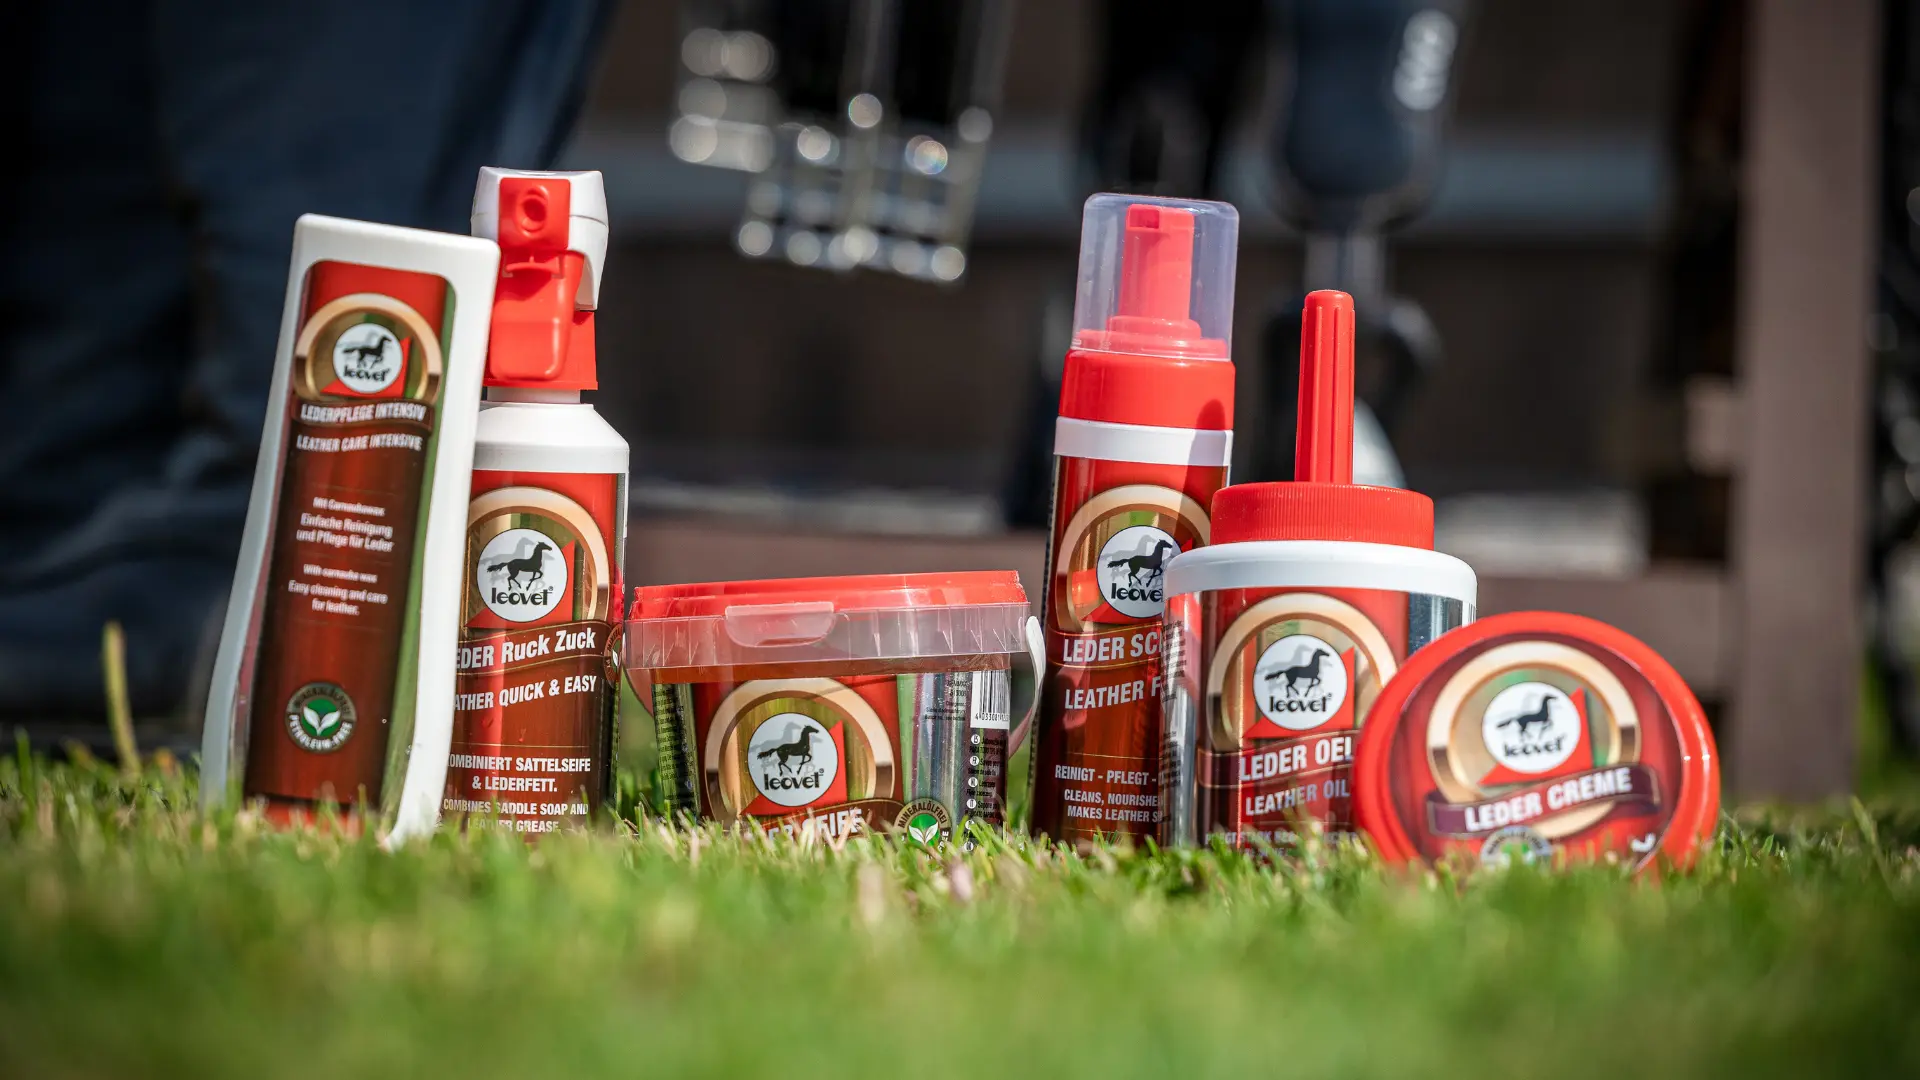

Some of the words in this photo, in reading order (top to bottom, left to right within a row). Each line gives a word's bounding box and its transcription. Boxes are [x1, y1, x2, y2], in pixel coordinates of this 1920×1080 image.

[343, 366, 390, 382] leovet
[301, 404, 375, 423] LEDERPFLEGE
[374, 402, 427, 421] INTENSIV
[296, 435, 340, 452] LEATHER
[341, 436, 369, 450] CARE
[369, 434, 423, 451] INTENSIVE
[491, 588, 552, 606] leovet
[1111, 583, 1164, 602] leove
[456, 646, 494, 669] DER
[501, 634, 551, 664] Ruck
[555, 628, 596, 652] Zuck
[1062, 636, 1124, 662] LEDER
[455, 692, 494, 710] ATHER
[499, 681, 544, 707] QUICK
[549, 679, 560, 695] &
[564, 676, 597, 694] EASY
[1065, 680, 1144, 710] LEATHER
[1270, 696, 1326, 712] leovet
[448, 754, 512, 770] OMBINIERT
[516, 757, 591, 772] SATTELSEIFE
[1240, 744, 1307, 782] LEDER
[1315, 736, 1354, 764] OEL
[472, 776, 482, 790] &
[485, 776, 558, 792] LEDERFETT.
[764, 772, 824, 790] leovet
[1055, 765, 1095, 782] REINIGT
[1106, 770, 1149, 786] PFLEGT
[1064, 789, 1104, 805] CLEANS,
[1246, 784, 1318, 816] LEATHER
[1323, 779, 1350, 798] OIL
[1464, 792, 1542, 832] LEDER
[1547, 767, 1632, 810] CREME
[444, 798, 491, 814] COMBINES
[540, 804, 568, 815] SOAP
[570, 804, 588, 815] AND
[898, 801, 948, 828] MINERALÖLFREI
[1068, 806, 1102, 820] MAKES
[1106, 809, 1150, 822] LEATHER
[468, 818, 513, 832] LEAER
